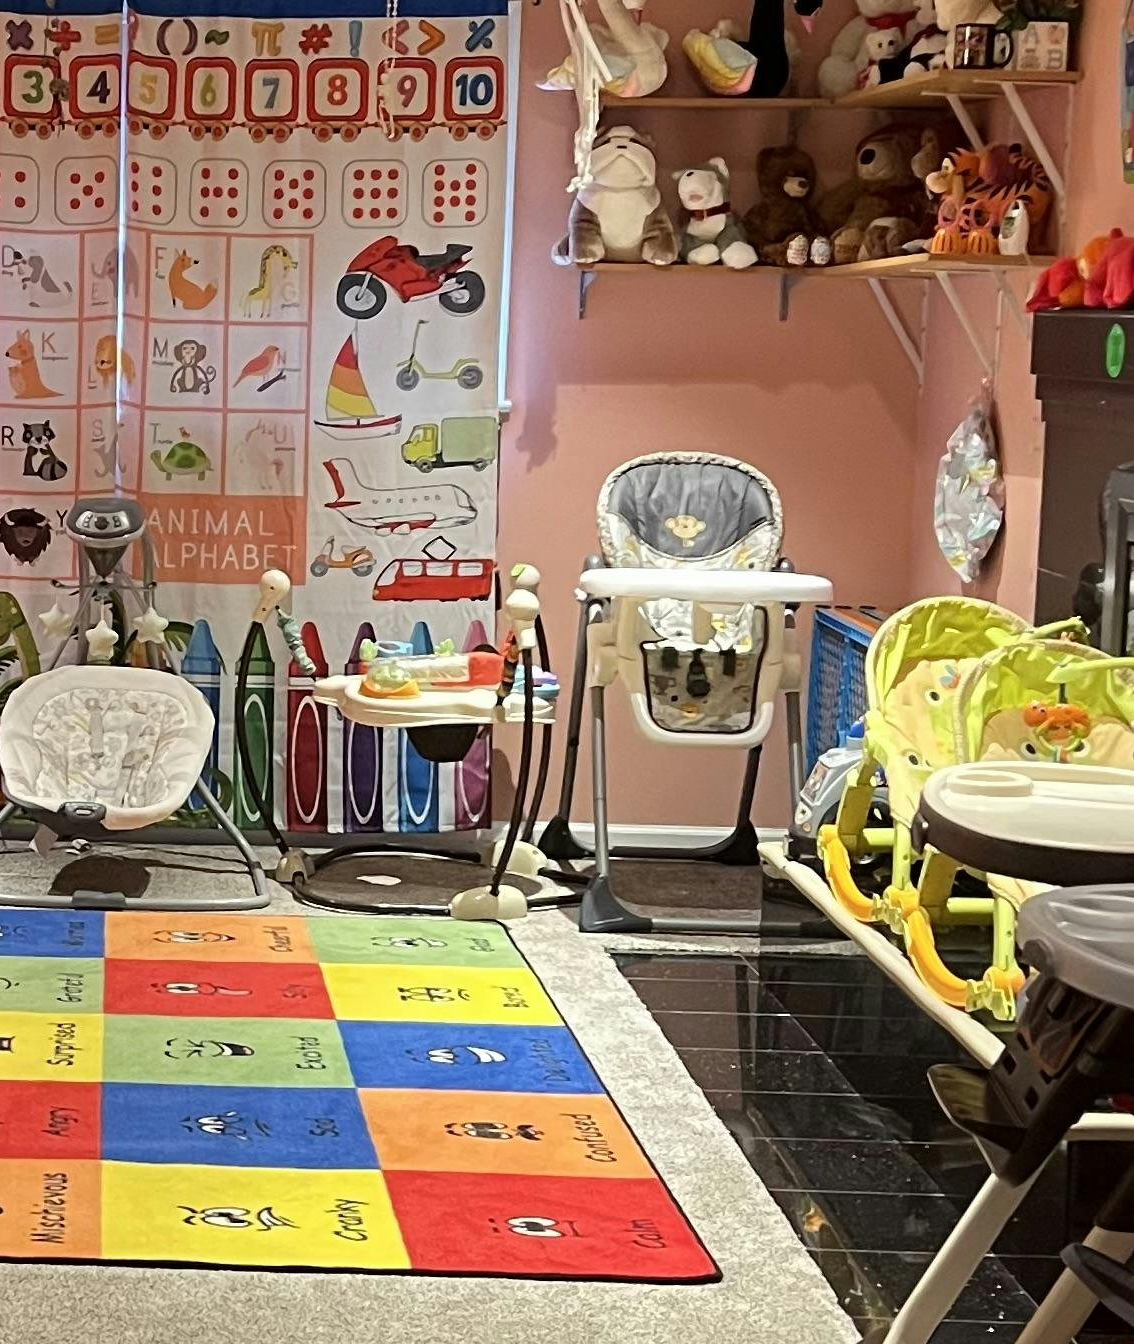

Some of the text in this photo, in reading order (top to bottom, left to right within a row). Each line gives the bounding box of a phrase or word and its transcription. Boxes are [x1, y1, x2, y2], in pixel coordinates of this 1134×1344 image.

[21, 70, 44, 105] 3
[85, 70, 111, 104] 4
[139, 75, 158, 105] 5
[201, 73, 217, 108] 6
[262, 77, 281, 111] 7
[327, 75, 348, 106] 8
[397, 74, 418, 109] 9
[455, 73, 494, 107] 10
[41, 332, 56, 353] K
[153, 336, 168, 358] M
[1, 425, 14, 446] R
[146, 508, 275, 537] ANIMAL
[46, 1022, 85, 1067] Surprised
[290, 1036, 326, 1072] Excited
[43, 1106, 79, 1138] Angry
[309, 1118, 340, 1138] Sad
[558, 1113, 618, 1164] Confused
[31, 1172, 68, 1246] Mischievous
[325, 1198, 370, 1244] Cranky
[630, 1219, 667, 1251] Calm
